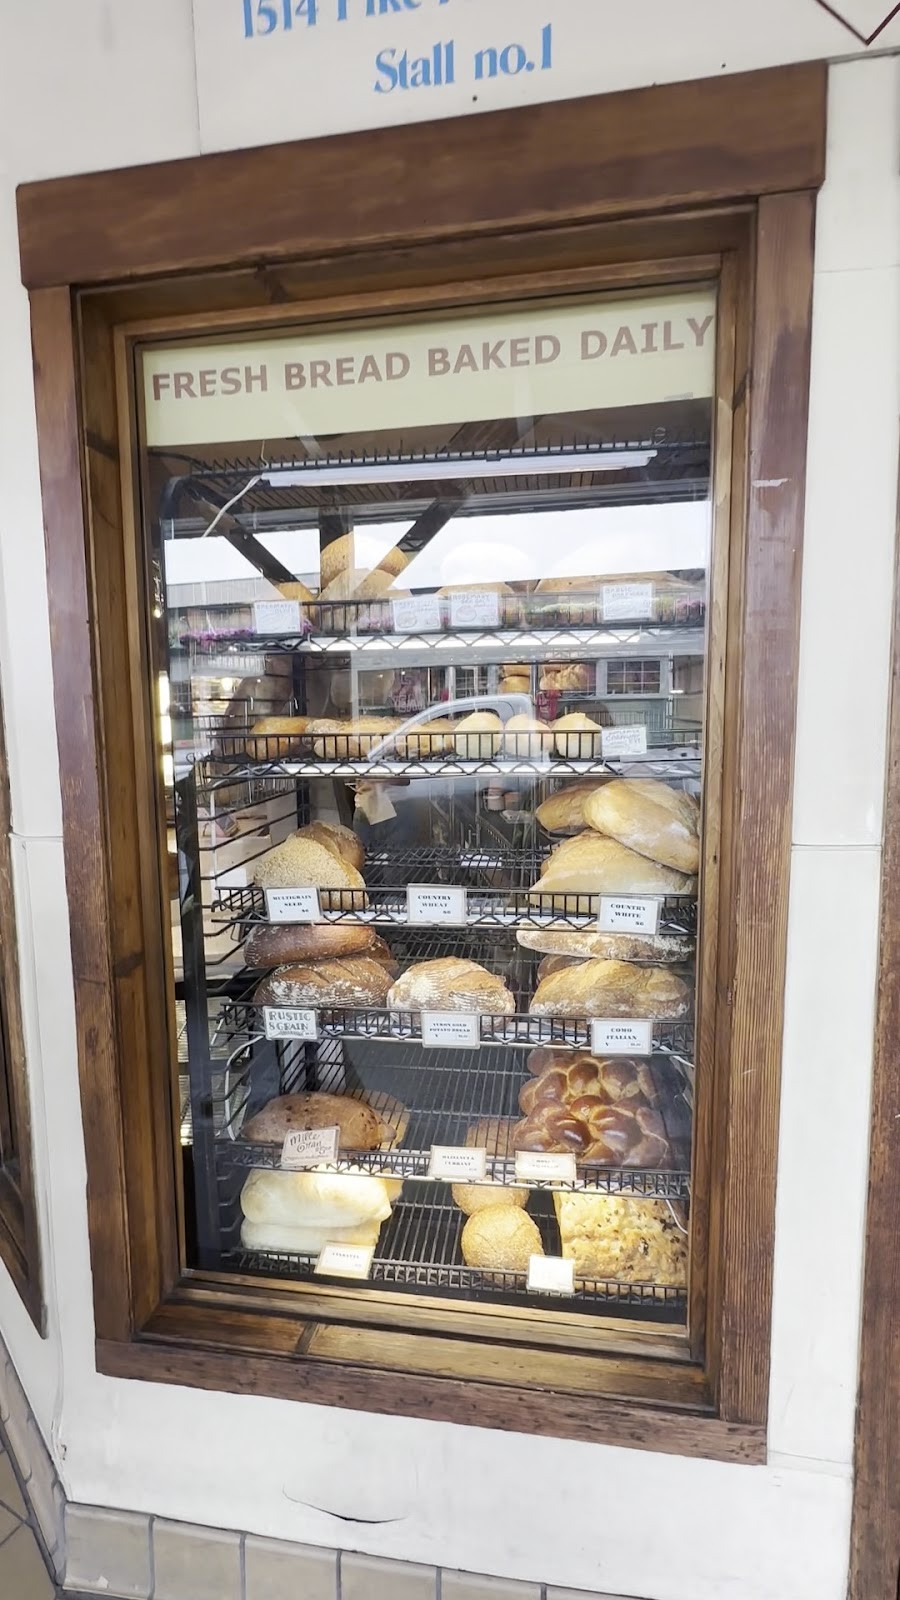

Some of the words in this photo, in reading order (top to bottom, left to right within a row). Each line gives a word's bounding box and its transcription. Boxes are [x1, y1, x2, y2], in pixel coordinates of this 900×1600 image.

[374, 39, 454, 94] Stall
[474, 22, 552, 80] no.1
[152, 364, 268, 401] FRESH
[284, 352, 411, 391] BREAD
[428, 335, 561, 377] BAKED
[581, 315, 714, 360] DAILY
[610, 903, 646, 911] COUNTRY
[268, 1010, 312, 1021] RUSTIC
